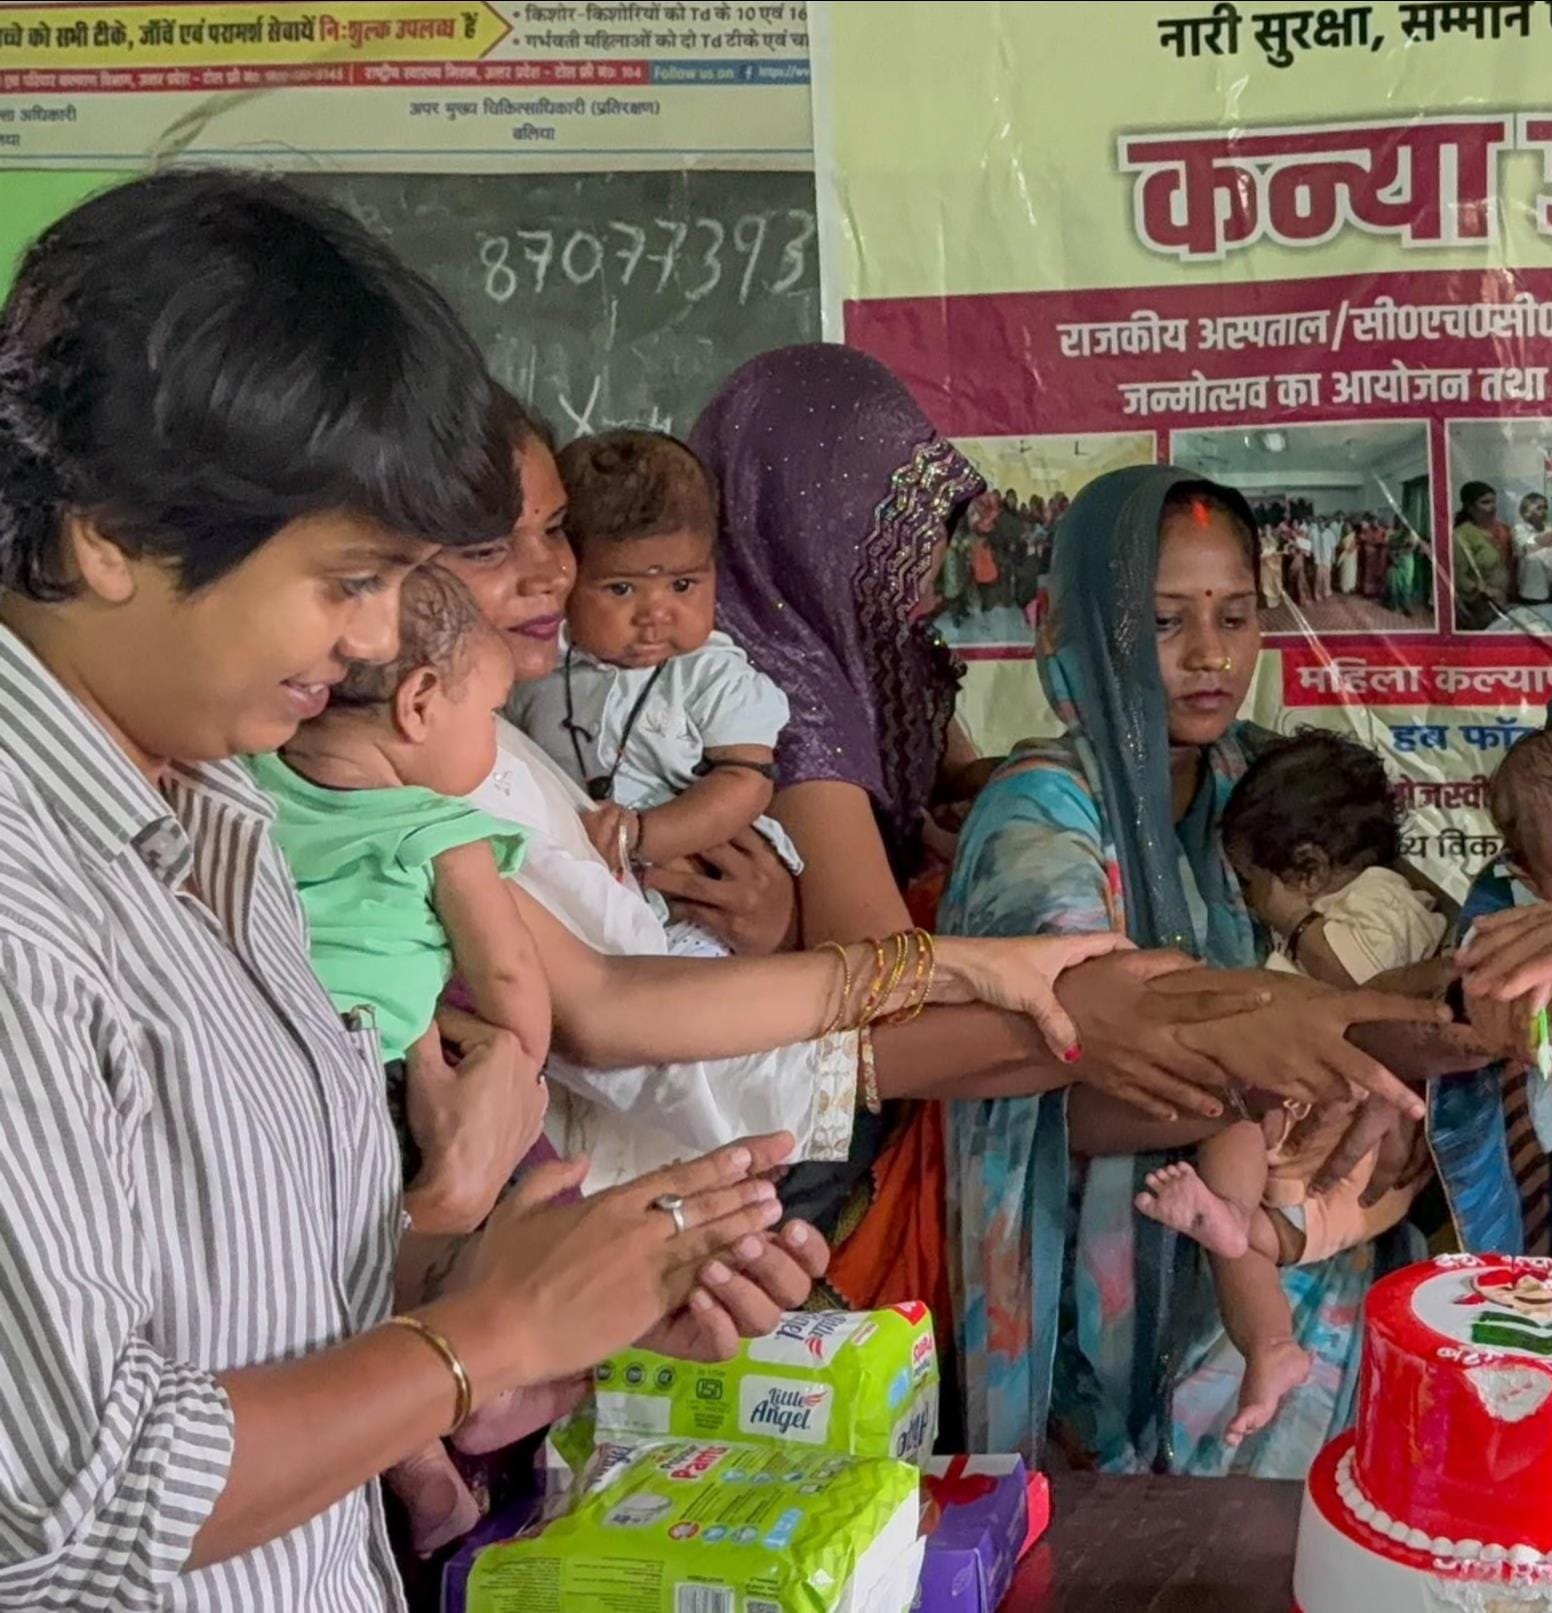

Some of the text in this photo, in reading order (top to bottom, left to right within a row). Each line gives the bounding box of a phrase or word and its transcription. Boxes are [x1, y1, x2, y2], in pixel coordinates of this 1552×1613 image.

[28, 21, 50, 47] को
[57, 20, 89, 47] सभी
[461, 12, 478, 39] हैं
[665, 4, 686, 21] को
[715, 4, 730, 21] के
[738, 7, 755, 21] 10
[584, 29, 650, 50] महिलाओं
[656, 32, 677, 48] को
[1157, 3, 1241, 58] नारी
[1253, 7, 1385, 67] सुरक्षा,
[1400, 2, 1532, 43] सम्मान
[654, 66, 697, 79] Follow
[410, 102, 439, 116] अपर
[1117, 112, 1514, 262] कन्या
[1057, 310, 1188, 358] राजकीय
[1118, 370, 1268, 417] जन्मोत्सव
[1275, 374, 1320, 409] का
[1332, 359, 1470, 405] आयोजन
[1479, 365, 1548, 402] तथा
[1297, 658, 1423, 694] महिला
[1389, 716, 1545, 752] हब फॉ
[768, 1387, 806, 1406] Little
[750, 1400, 811, 1434] Angel
